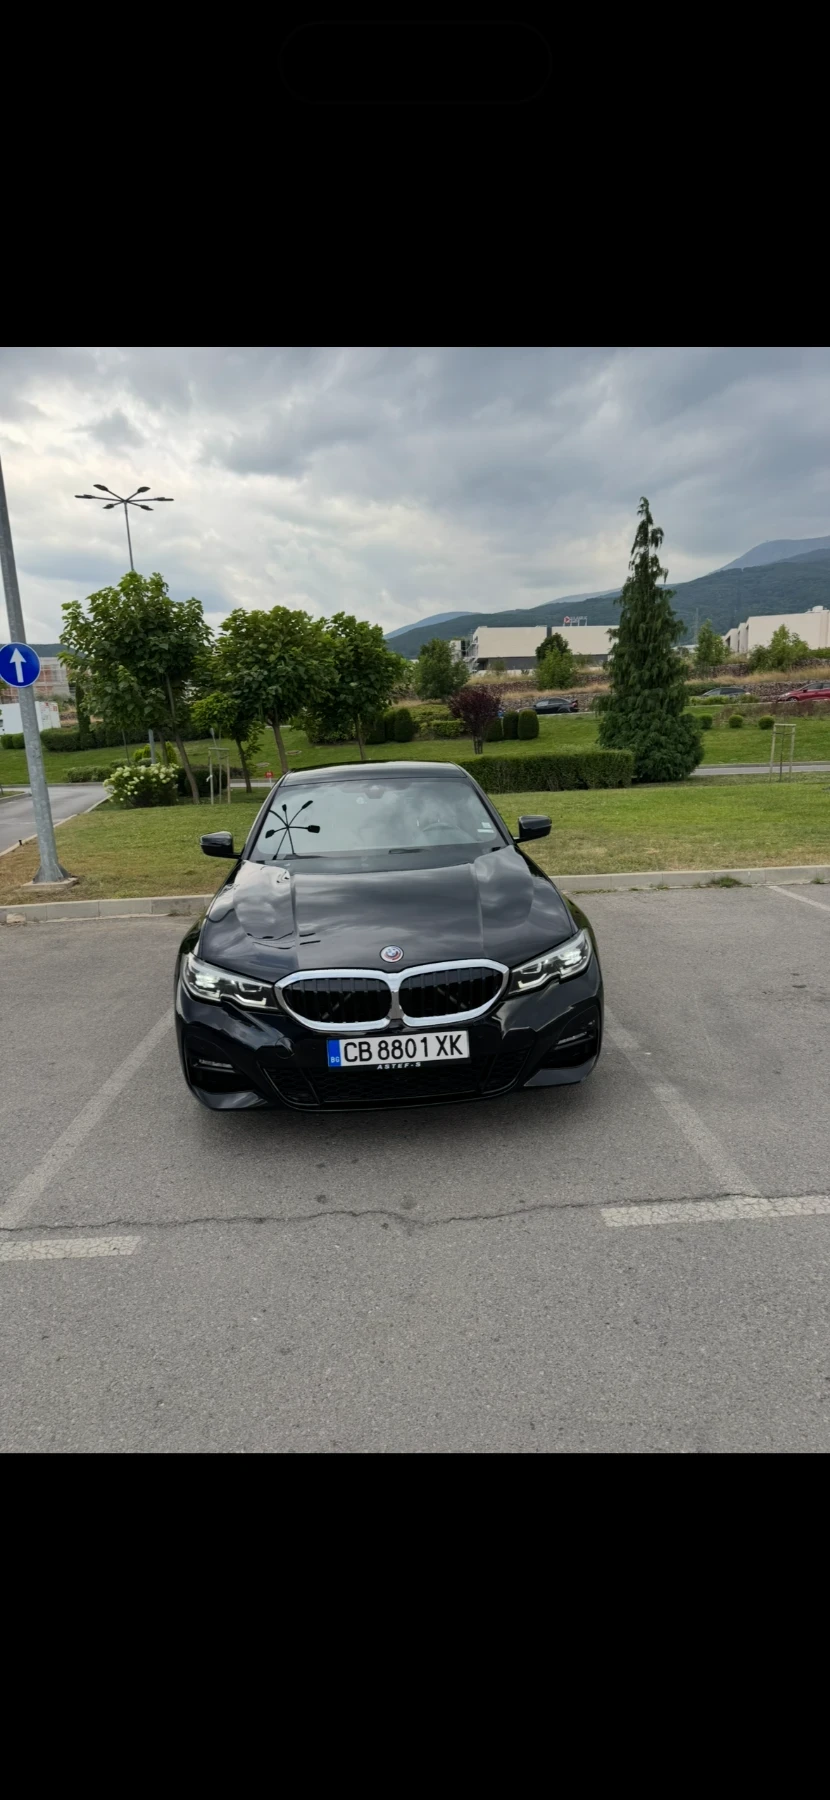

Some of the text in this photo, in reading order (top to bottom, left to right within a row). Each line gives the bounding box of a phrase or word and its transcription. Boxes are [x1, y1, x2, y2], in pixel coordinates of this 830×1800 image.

[344, 1034, 463, 1063] CB 8801 XK
